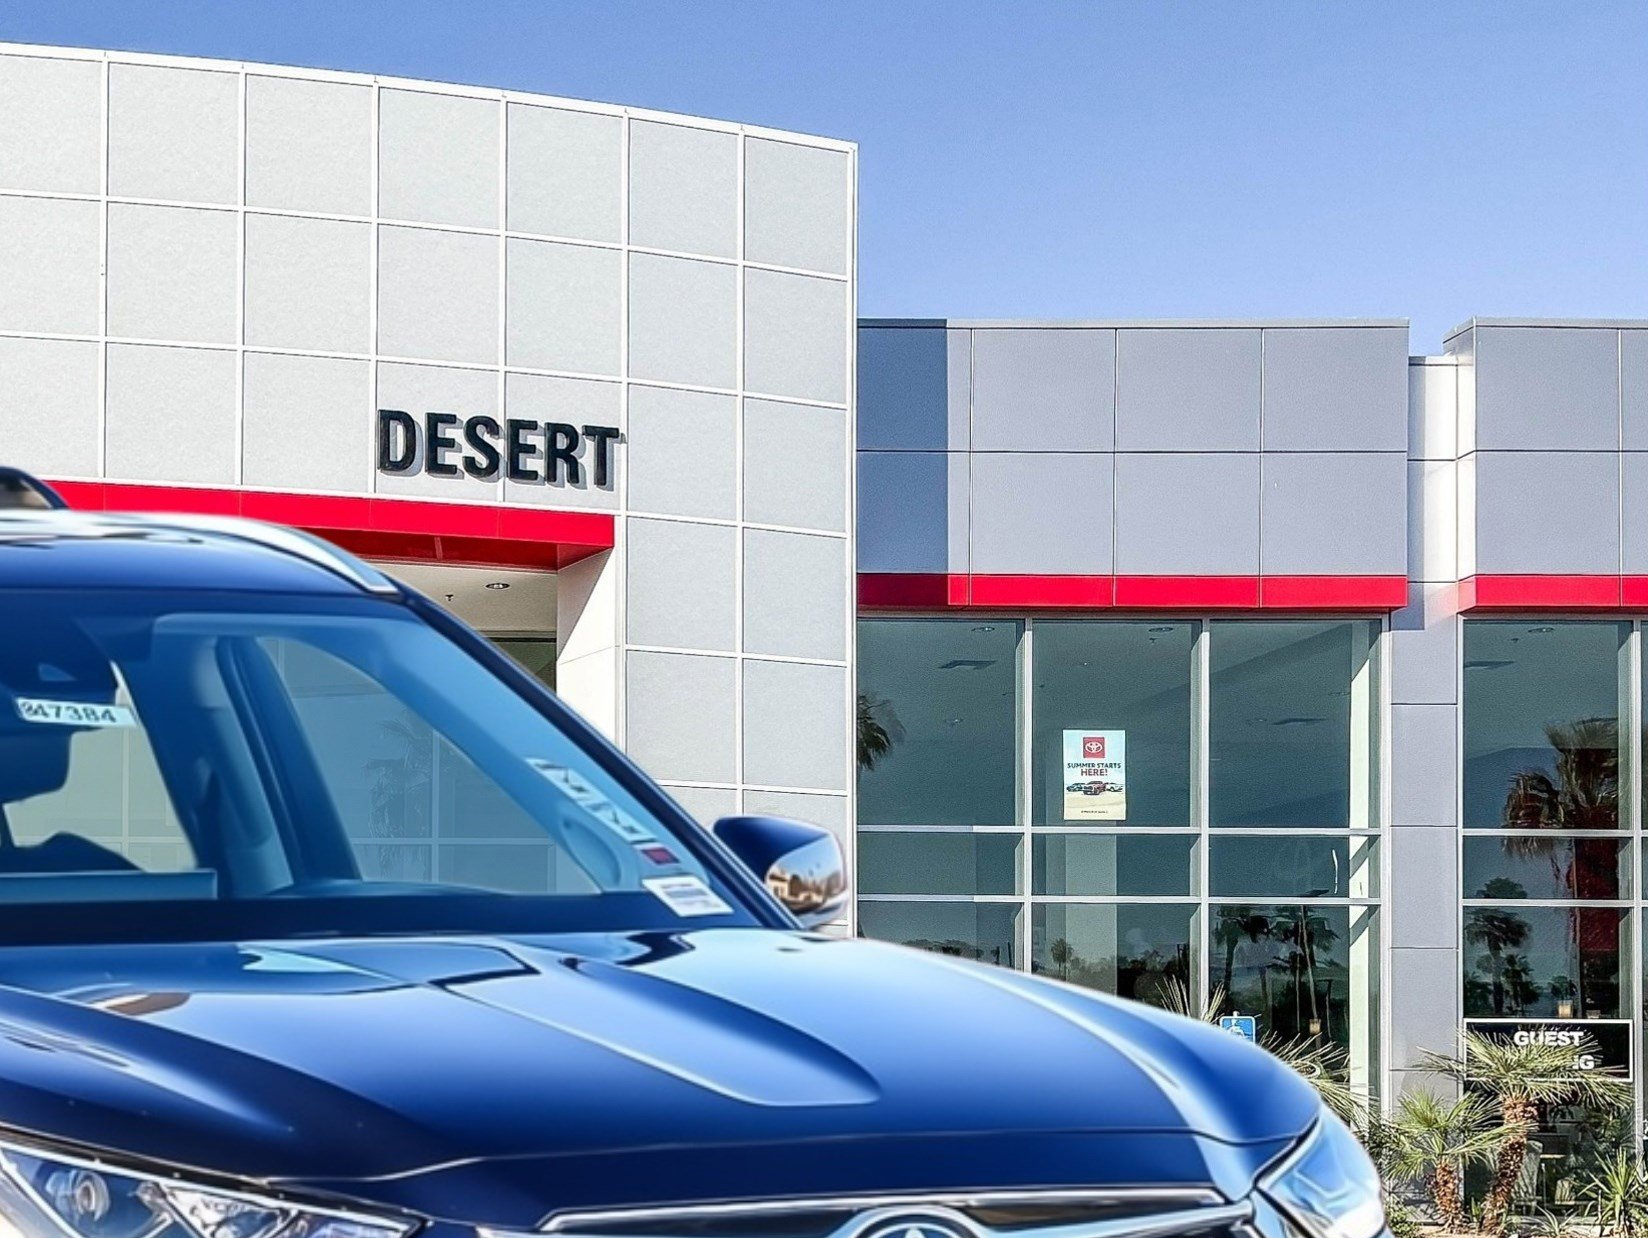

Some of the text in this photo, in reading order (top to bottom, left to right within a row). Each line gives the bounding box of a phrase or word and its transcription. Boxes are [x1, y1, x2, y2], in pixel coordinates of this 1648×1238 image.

[377, 409, 621, 487] DESERT
[1080, 768, 1108, 777] HERE!
[1513, 1030, 1584, 1047] GUEST
